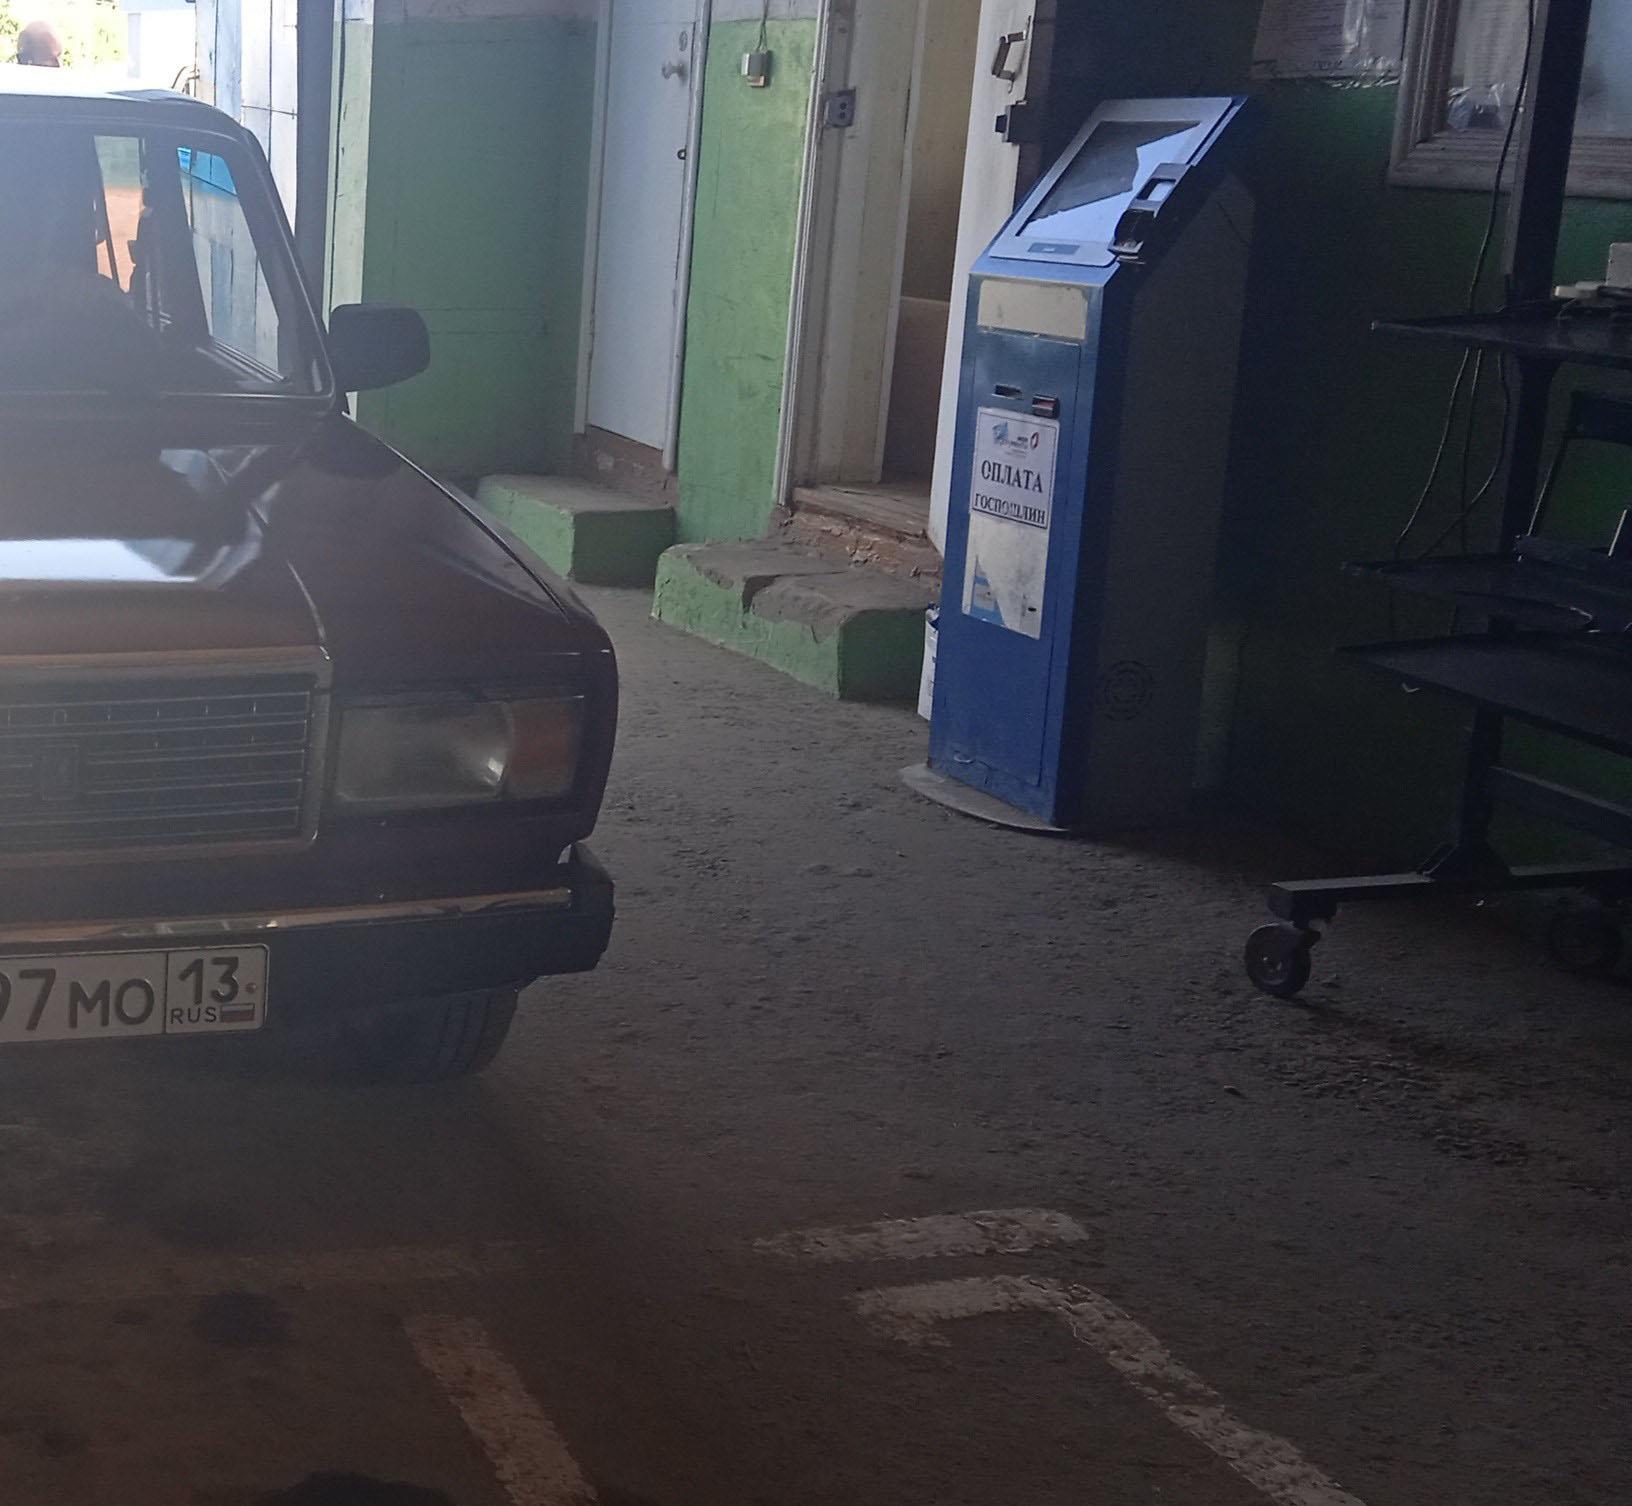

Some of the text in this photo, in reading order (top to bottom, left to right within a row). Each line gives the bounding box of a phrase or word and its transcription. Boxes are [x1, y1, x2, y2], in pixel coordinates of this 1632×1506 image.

[981, 460, 1043, 493] ОПЛАТА
[974, 493, 1046, 524] ГОСПОШЛИН
[178, 957, 240, 1006] 13
[170, 1006, 217, 1025] RUS
